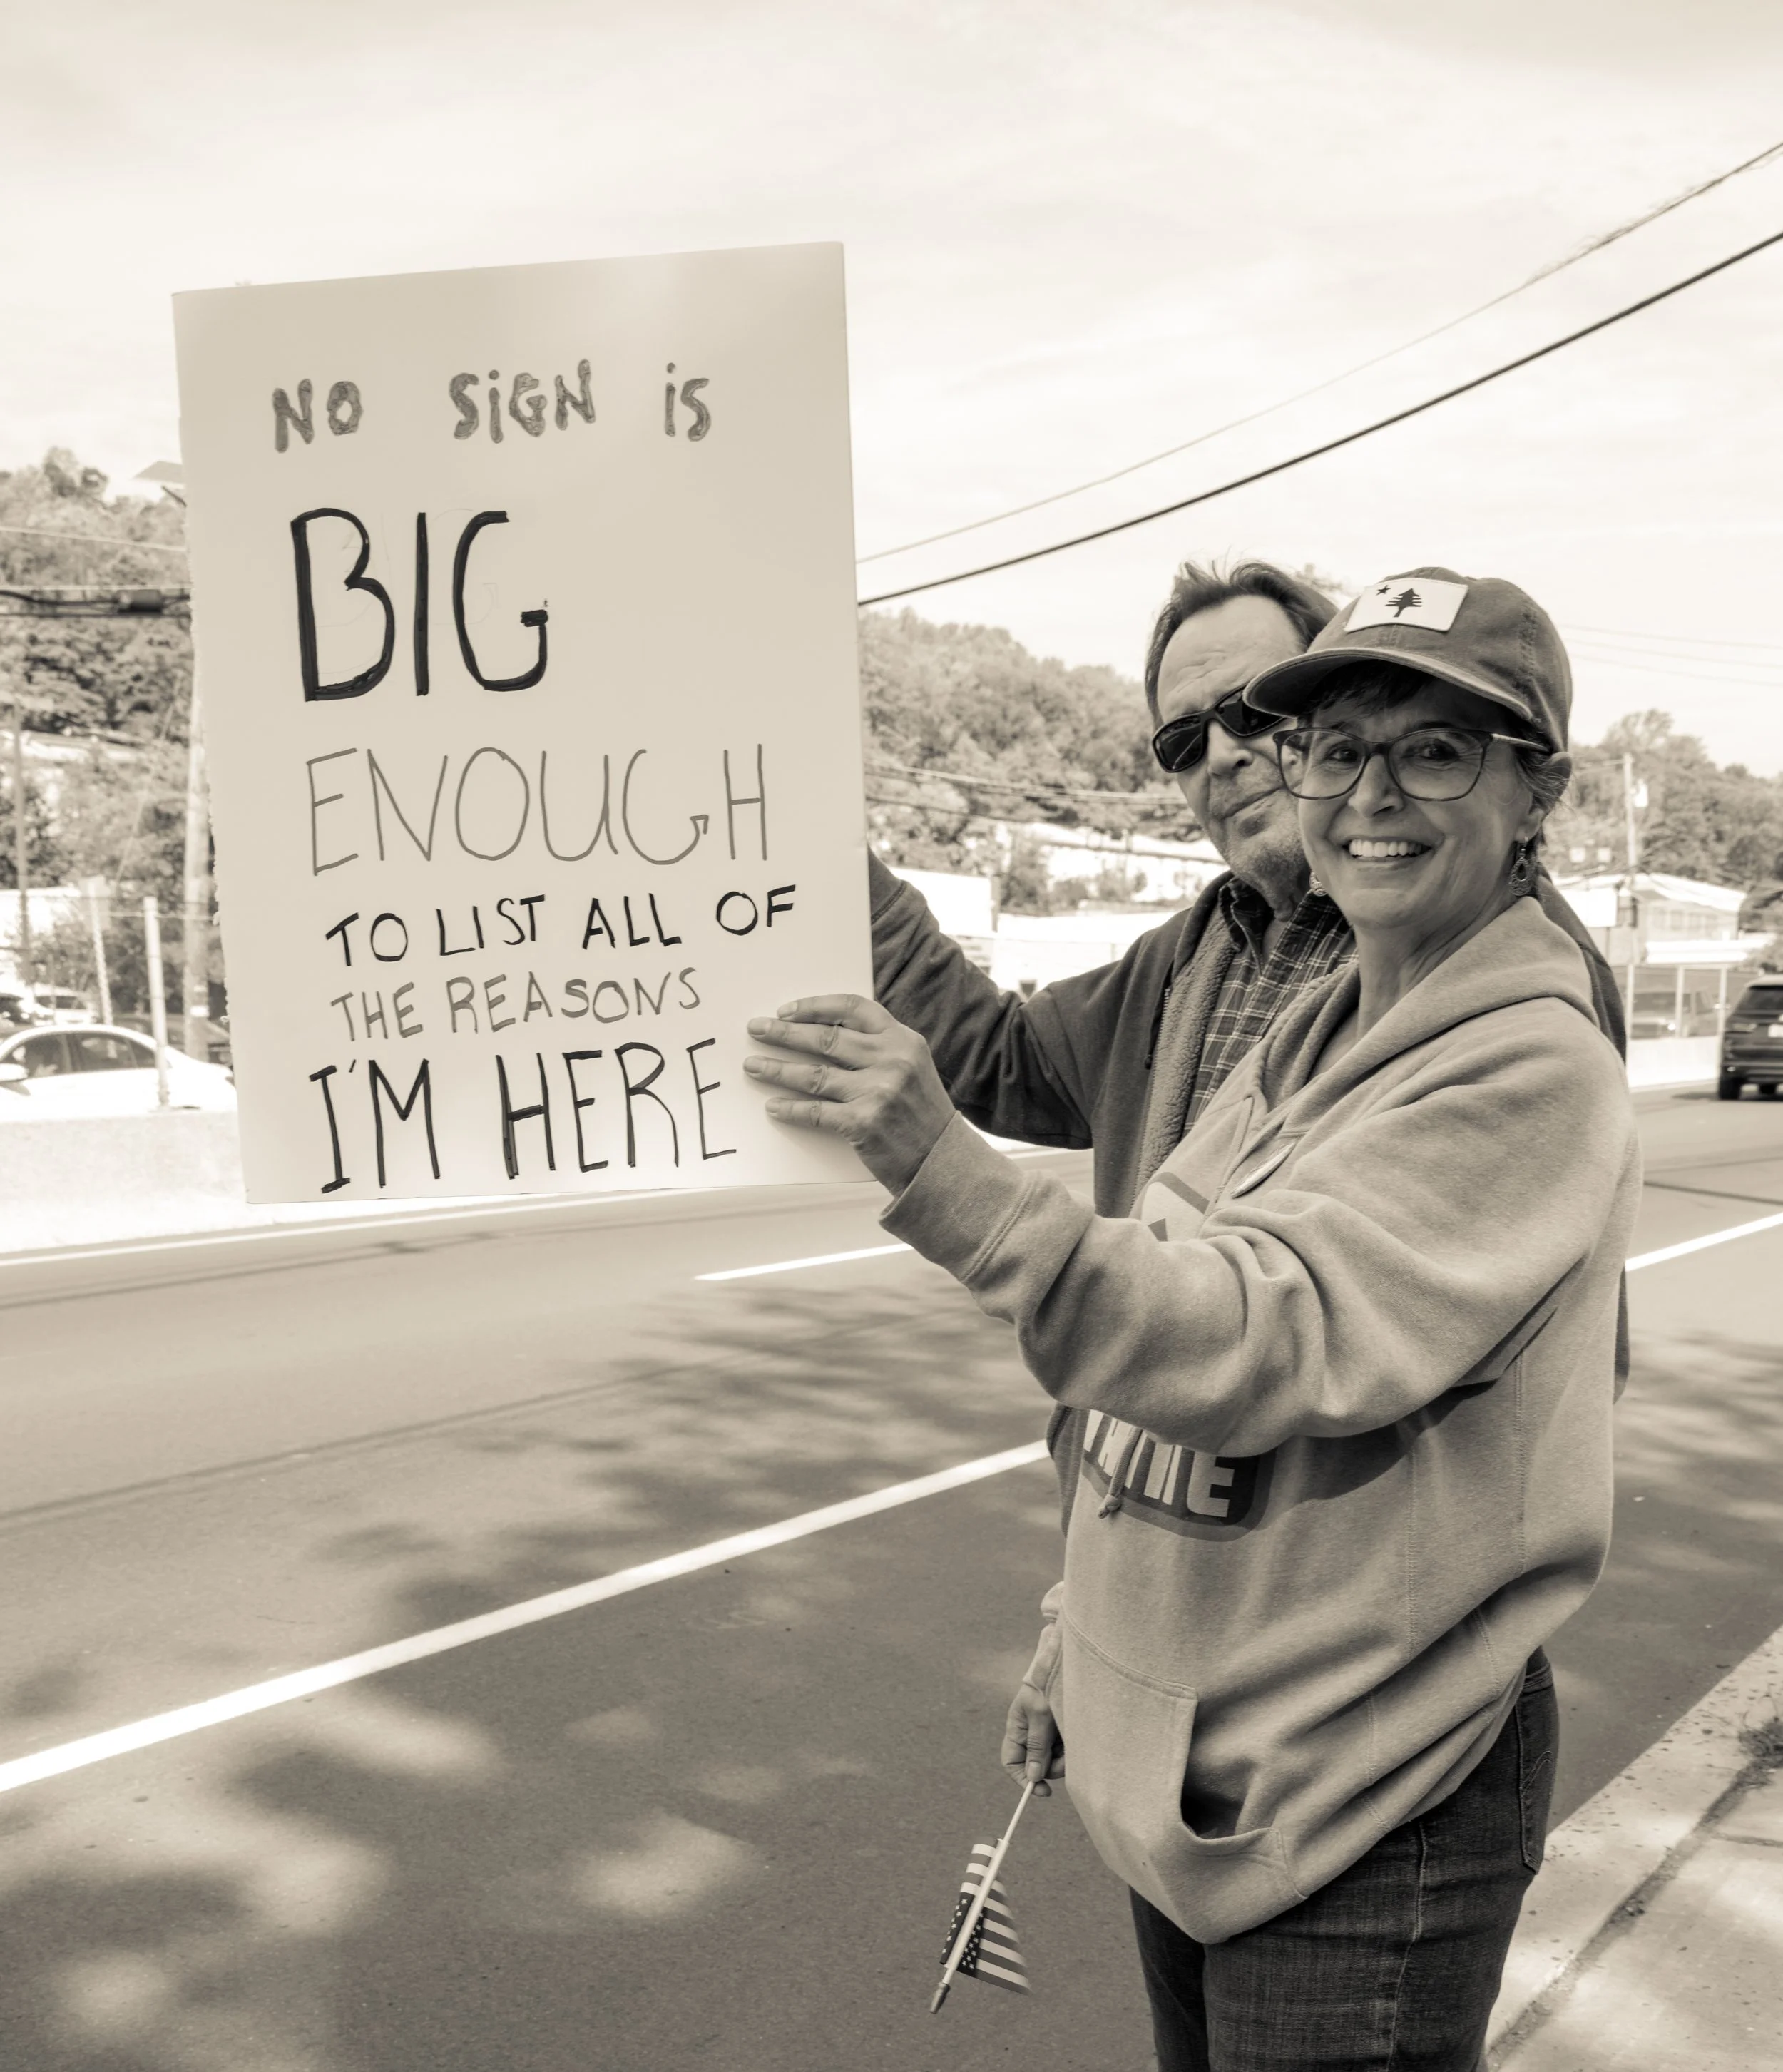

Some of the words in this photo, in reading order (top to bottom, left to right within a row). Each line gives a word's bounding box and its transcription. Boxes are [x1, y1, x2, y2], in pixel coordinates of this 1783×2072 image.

[272, 379, 362, 453] NO
[290, 508, 548, 702] BIG
[306, 744, 767, 876] ENOUGH
[325, 912, 408, 966] TO
[436, 894, 545, 956] LIST
[582, 893, 682, 950] ALL
[715, 884, 796, 936] OF
[331, 982, 423, 1041] THE
[446, 967, 700, 1034] REASONS
[309, 1058, 440, 1193] I'M
[495, 1038, 736, 1180] HERE
